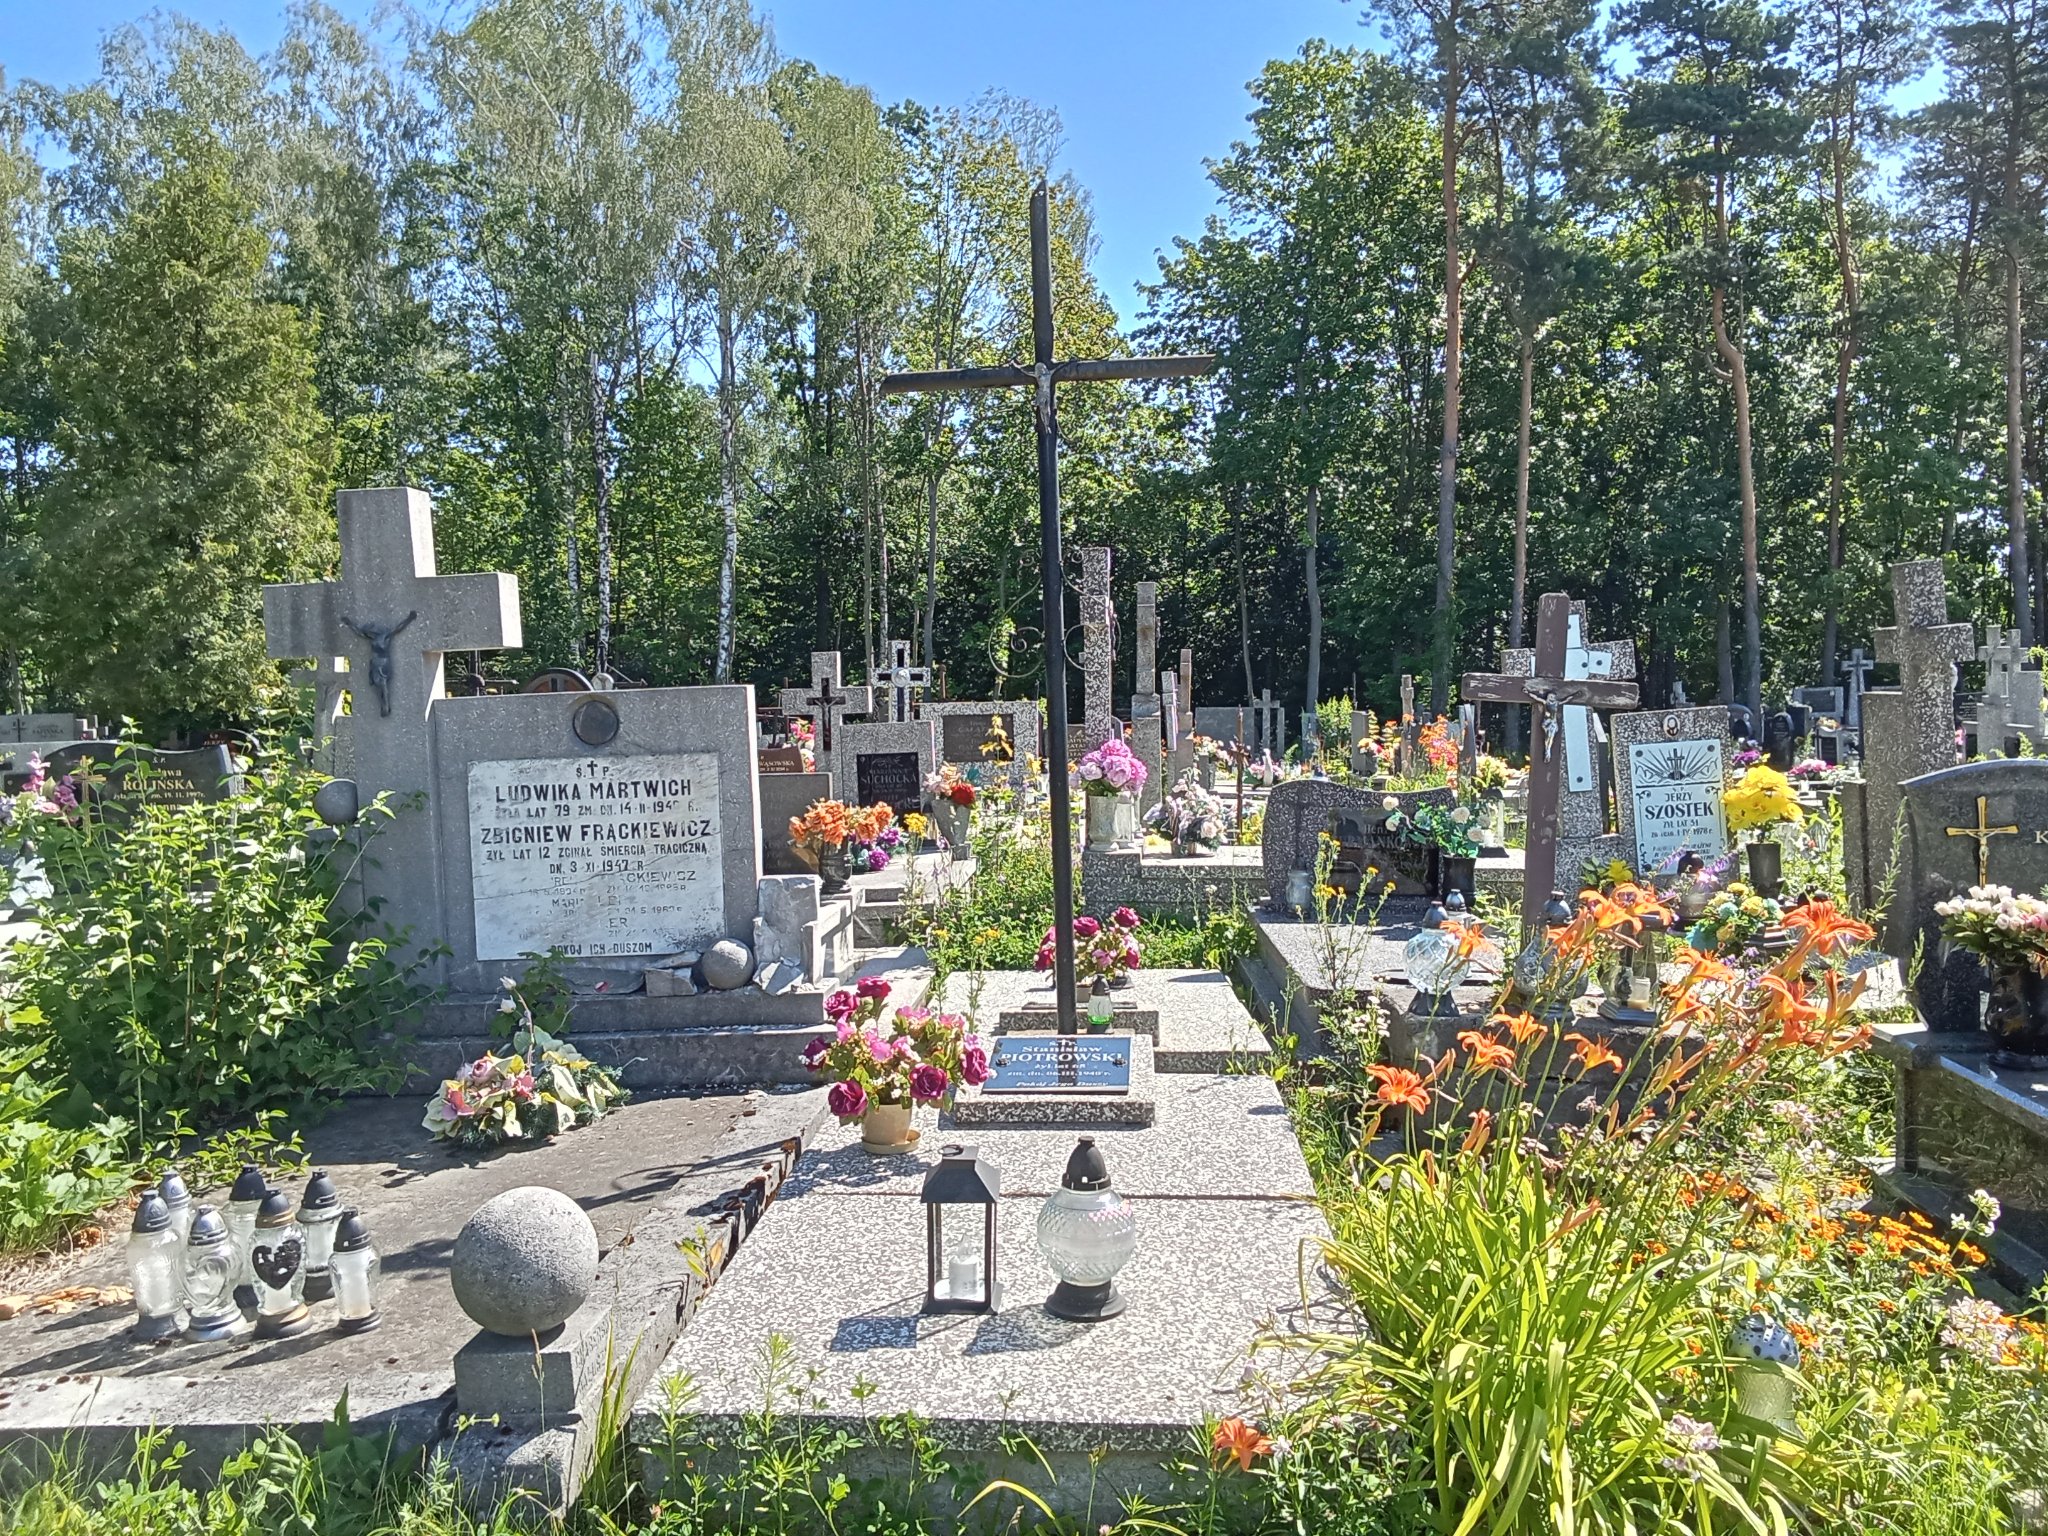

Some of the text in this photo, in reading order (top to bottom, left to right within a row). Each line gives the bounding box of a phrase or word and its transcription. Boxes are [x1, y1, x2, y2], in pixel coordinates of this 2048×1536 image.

[495, 779, 691, 803] LUDWIKA MARTWICH
[1665, 792, 1693, 802] JERZY
[527, 807, 547, 818] LAT
[554, 804, 570, 816] 79
[1645, 801, 1714, 820] SZOSTEK
[481, 820, 711, 845] ZBIGNIEW FRĄCKIEWICZ
[513, 849, 531, 860] LAT
[539, 846, 550, 859] 12
[589, 943, 606, 956] ICH
[613, 942, 653, 955] DUSZOM
[1000, 1053, 1122, 1063] PIOTROWSKI
